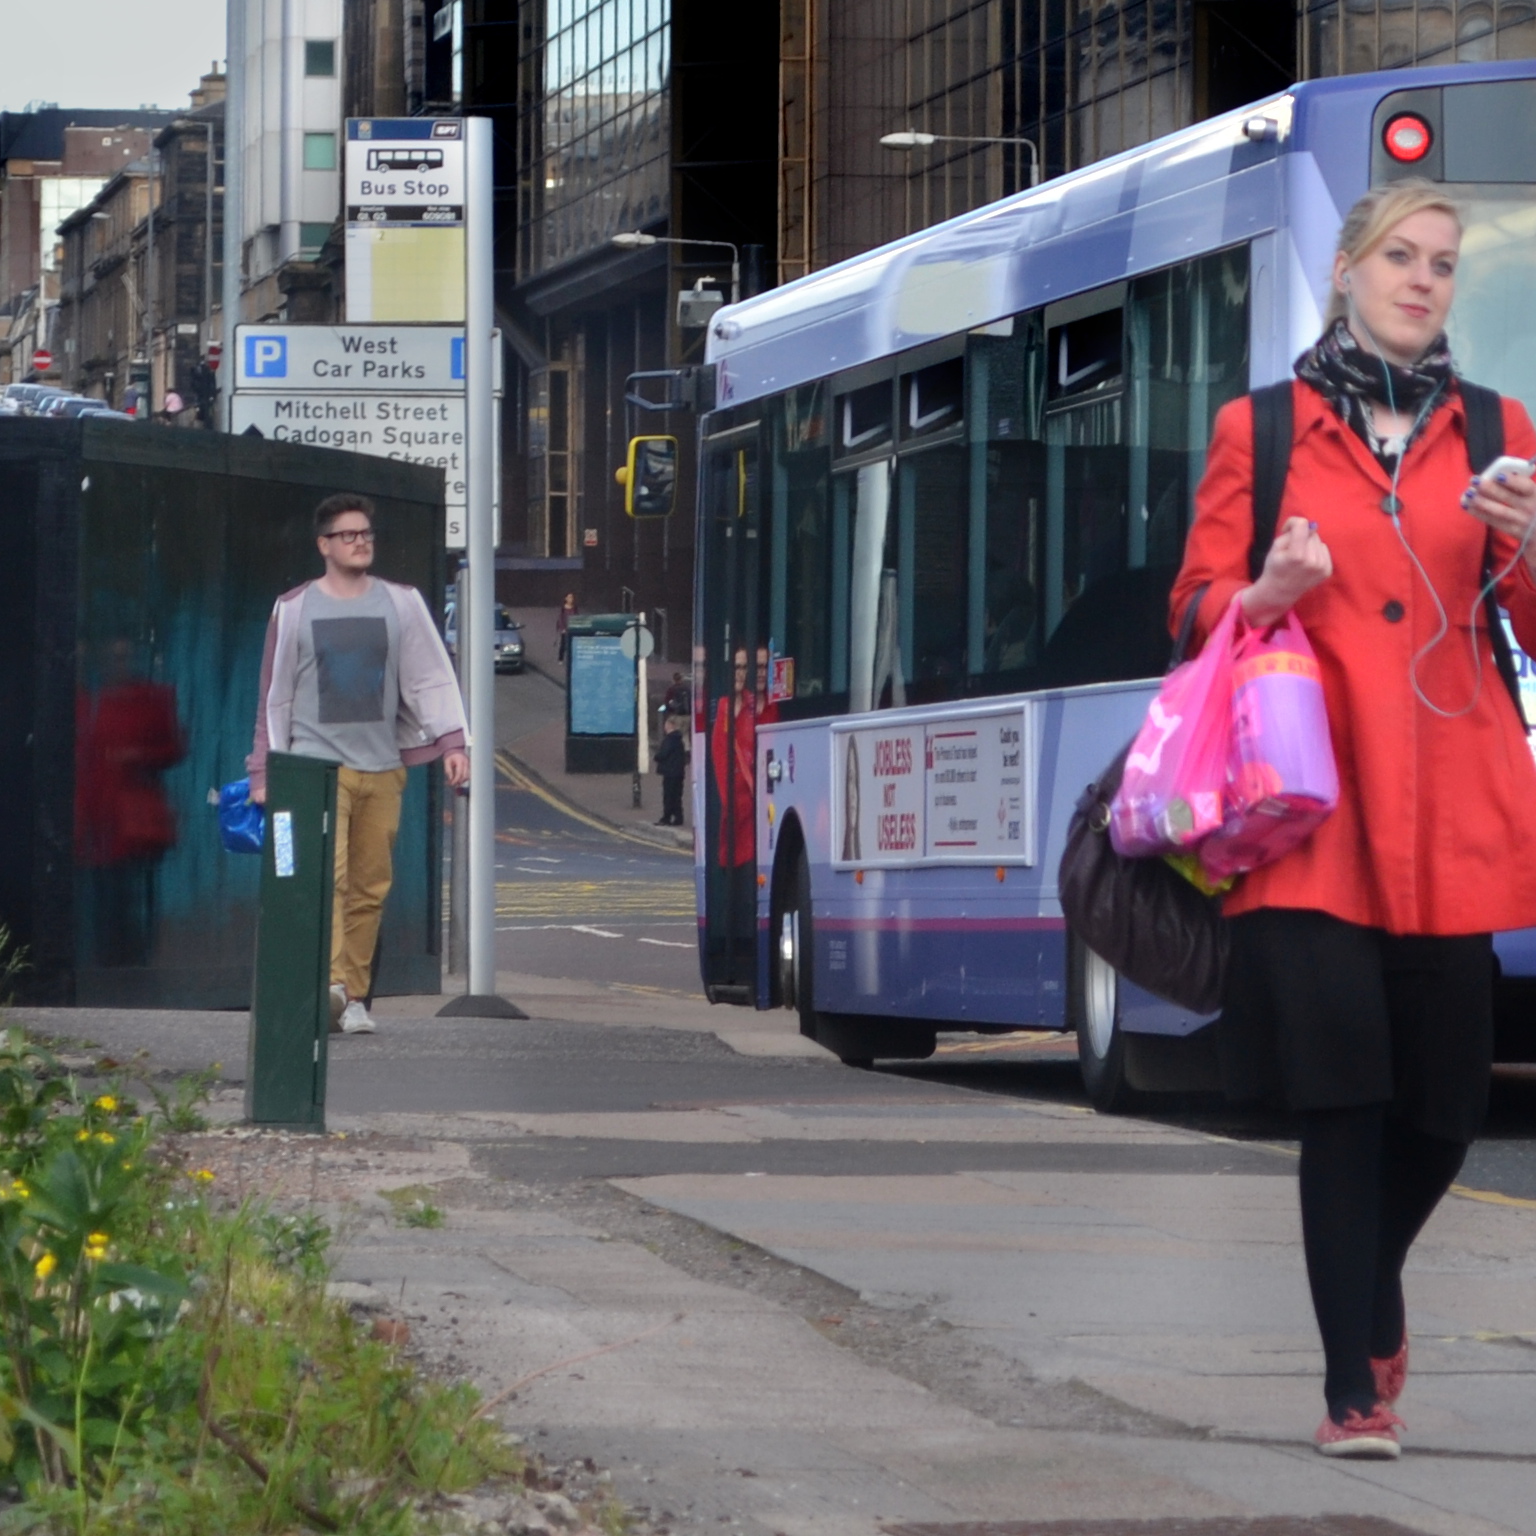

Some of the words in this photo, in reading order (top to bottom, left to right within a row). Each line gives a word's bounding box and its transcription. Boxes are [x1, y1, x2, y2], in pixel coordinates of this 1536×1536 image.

[360, 180, 397, 196] Bus
[403, 180, 450, 198] Stop
[341, 335, 399, 354] West
[254, 339, 283, 375] P
[312, 359, 352, 378] Car
[362, 360, 426, 379] Parks
[273, 399, 368, 420] Mitchell
[375, 401, 449, 421] Street
[272, 424, 373, 447] Cadogan
[382, 425, 465, 448] Square
